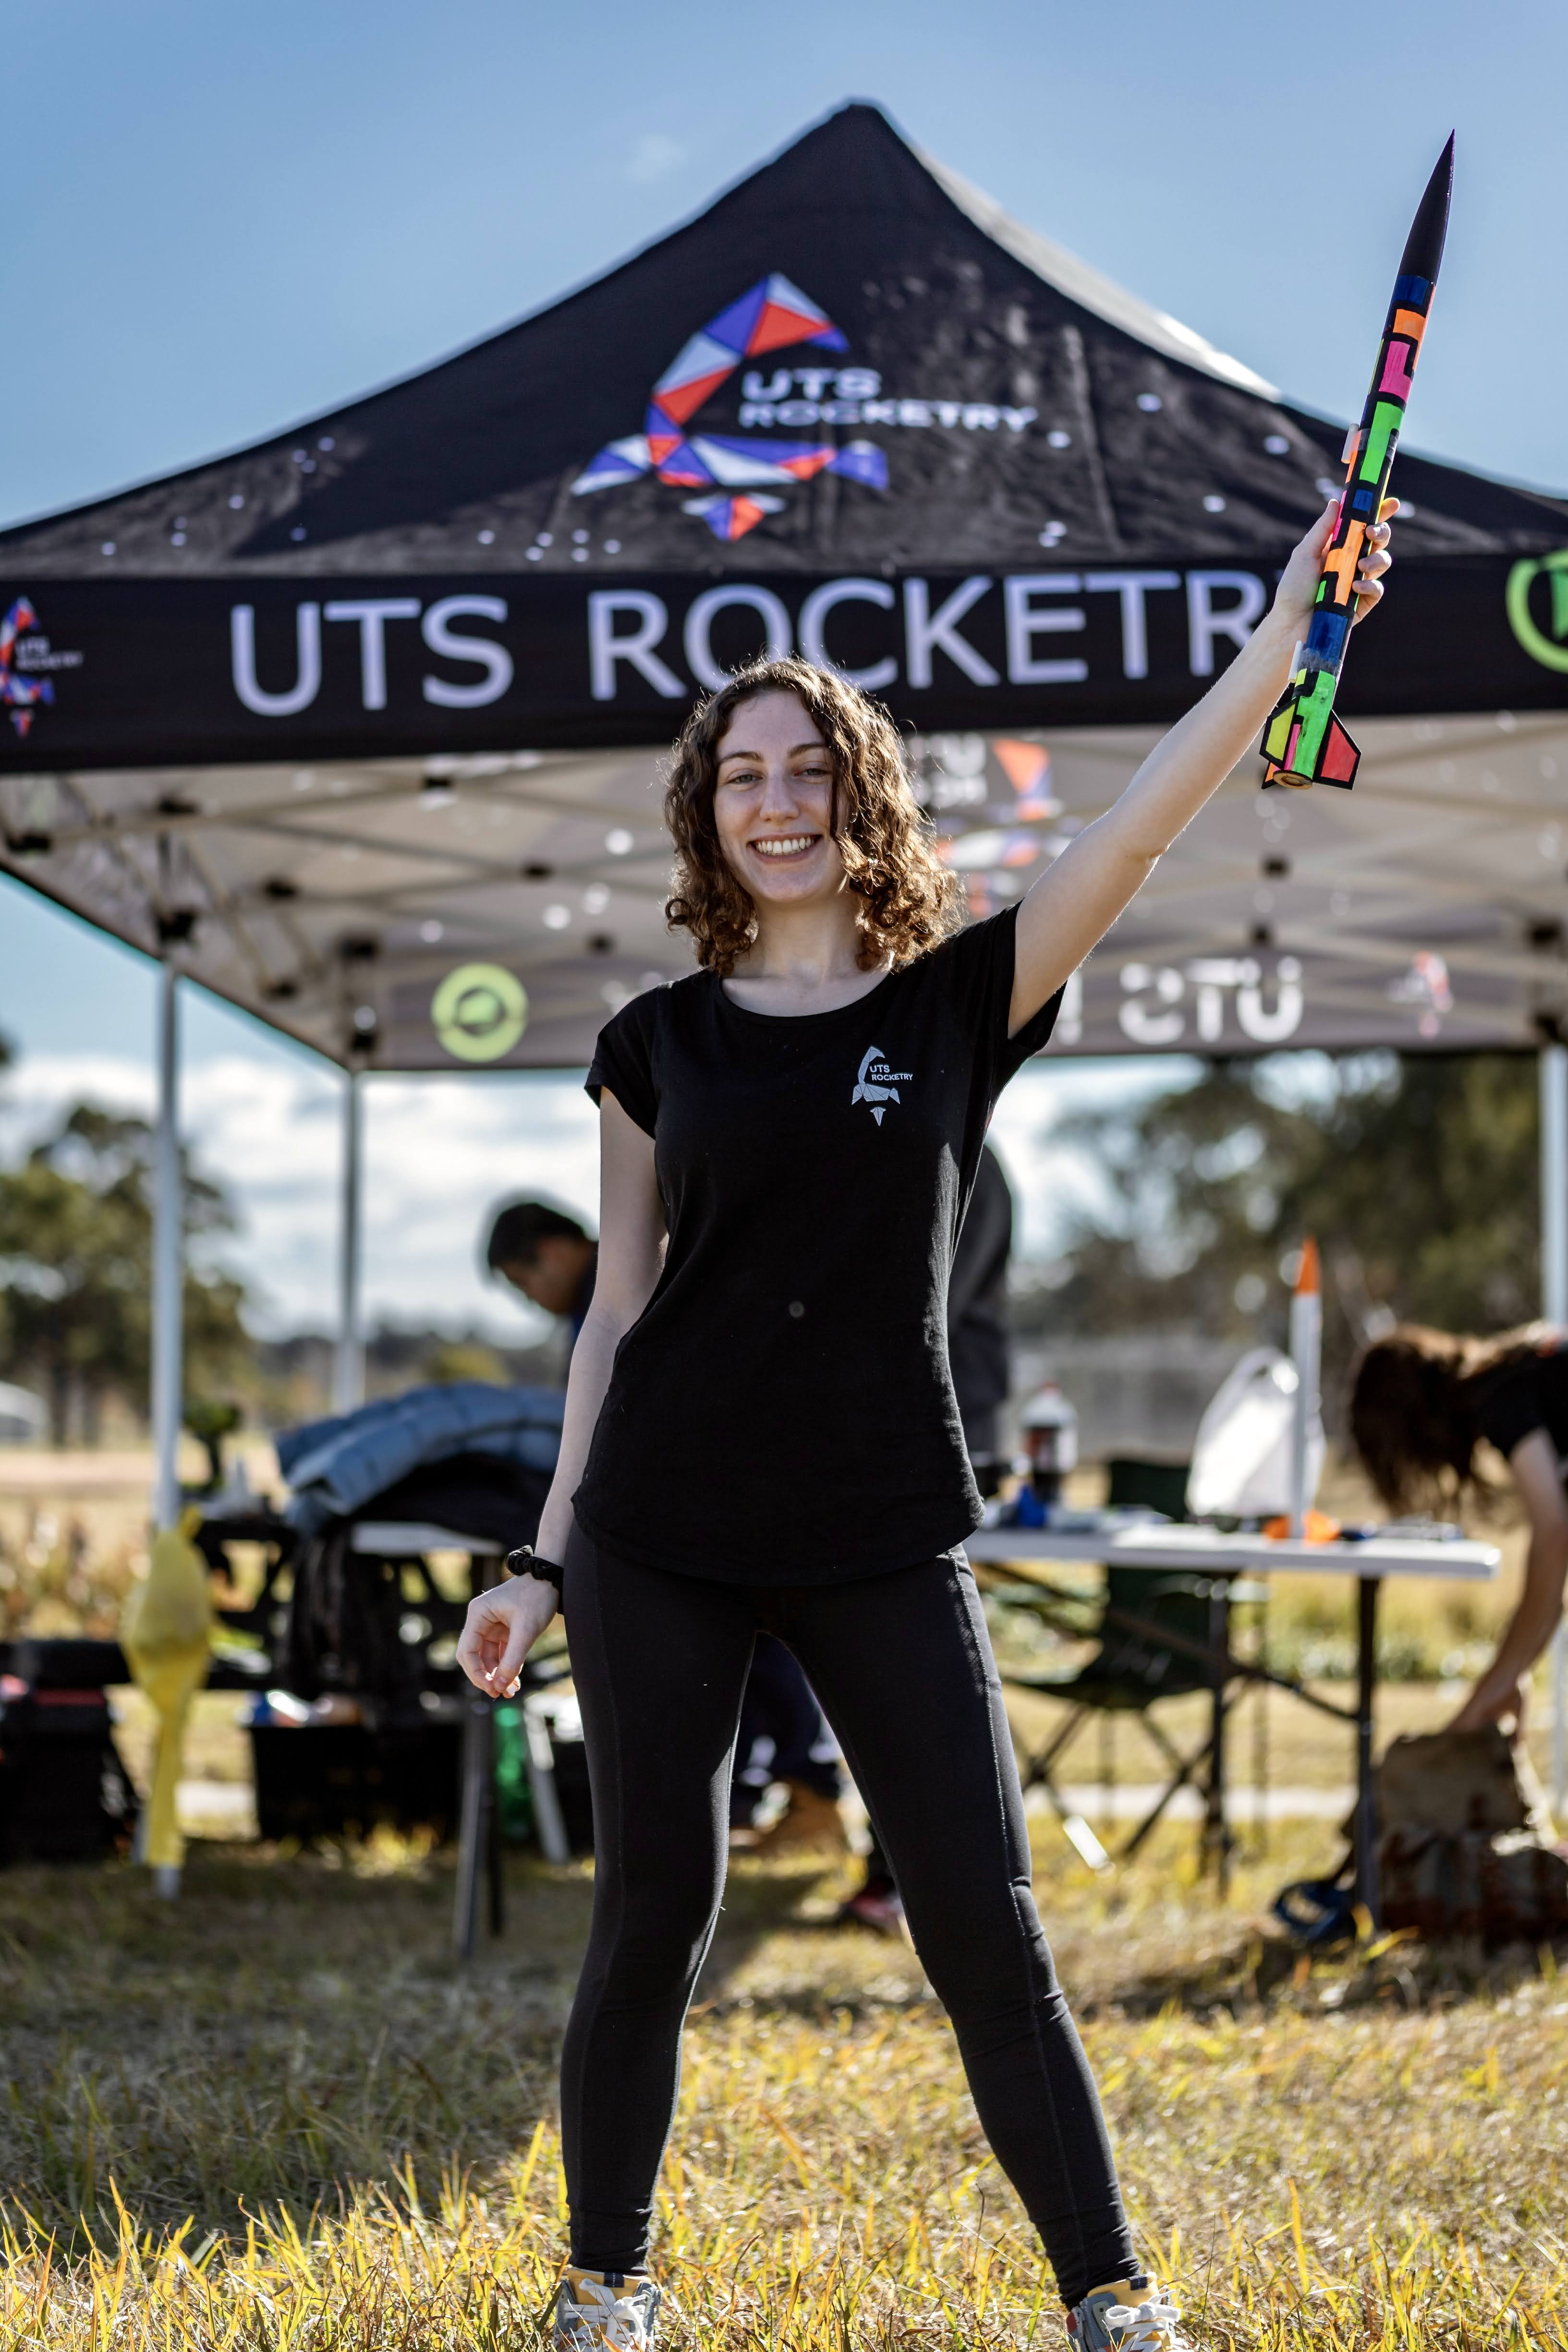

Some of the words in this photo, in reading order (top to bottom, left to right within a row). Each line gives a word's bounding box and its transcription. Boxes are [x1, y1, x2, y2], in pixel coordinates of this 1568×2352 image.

[742, 368, 882, 400] UTS
[739, 400, 1037, 432] ROCKETRY
[231, 594, 514, 716] UTS
[587, 570, 1282, 702] ROCKETR
